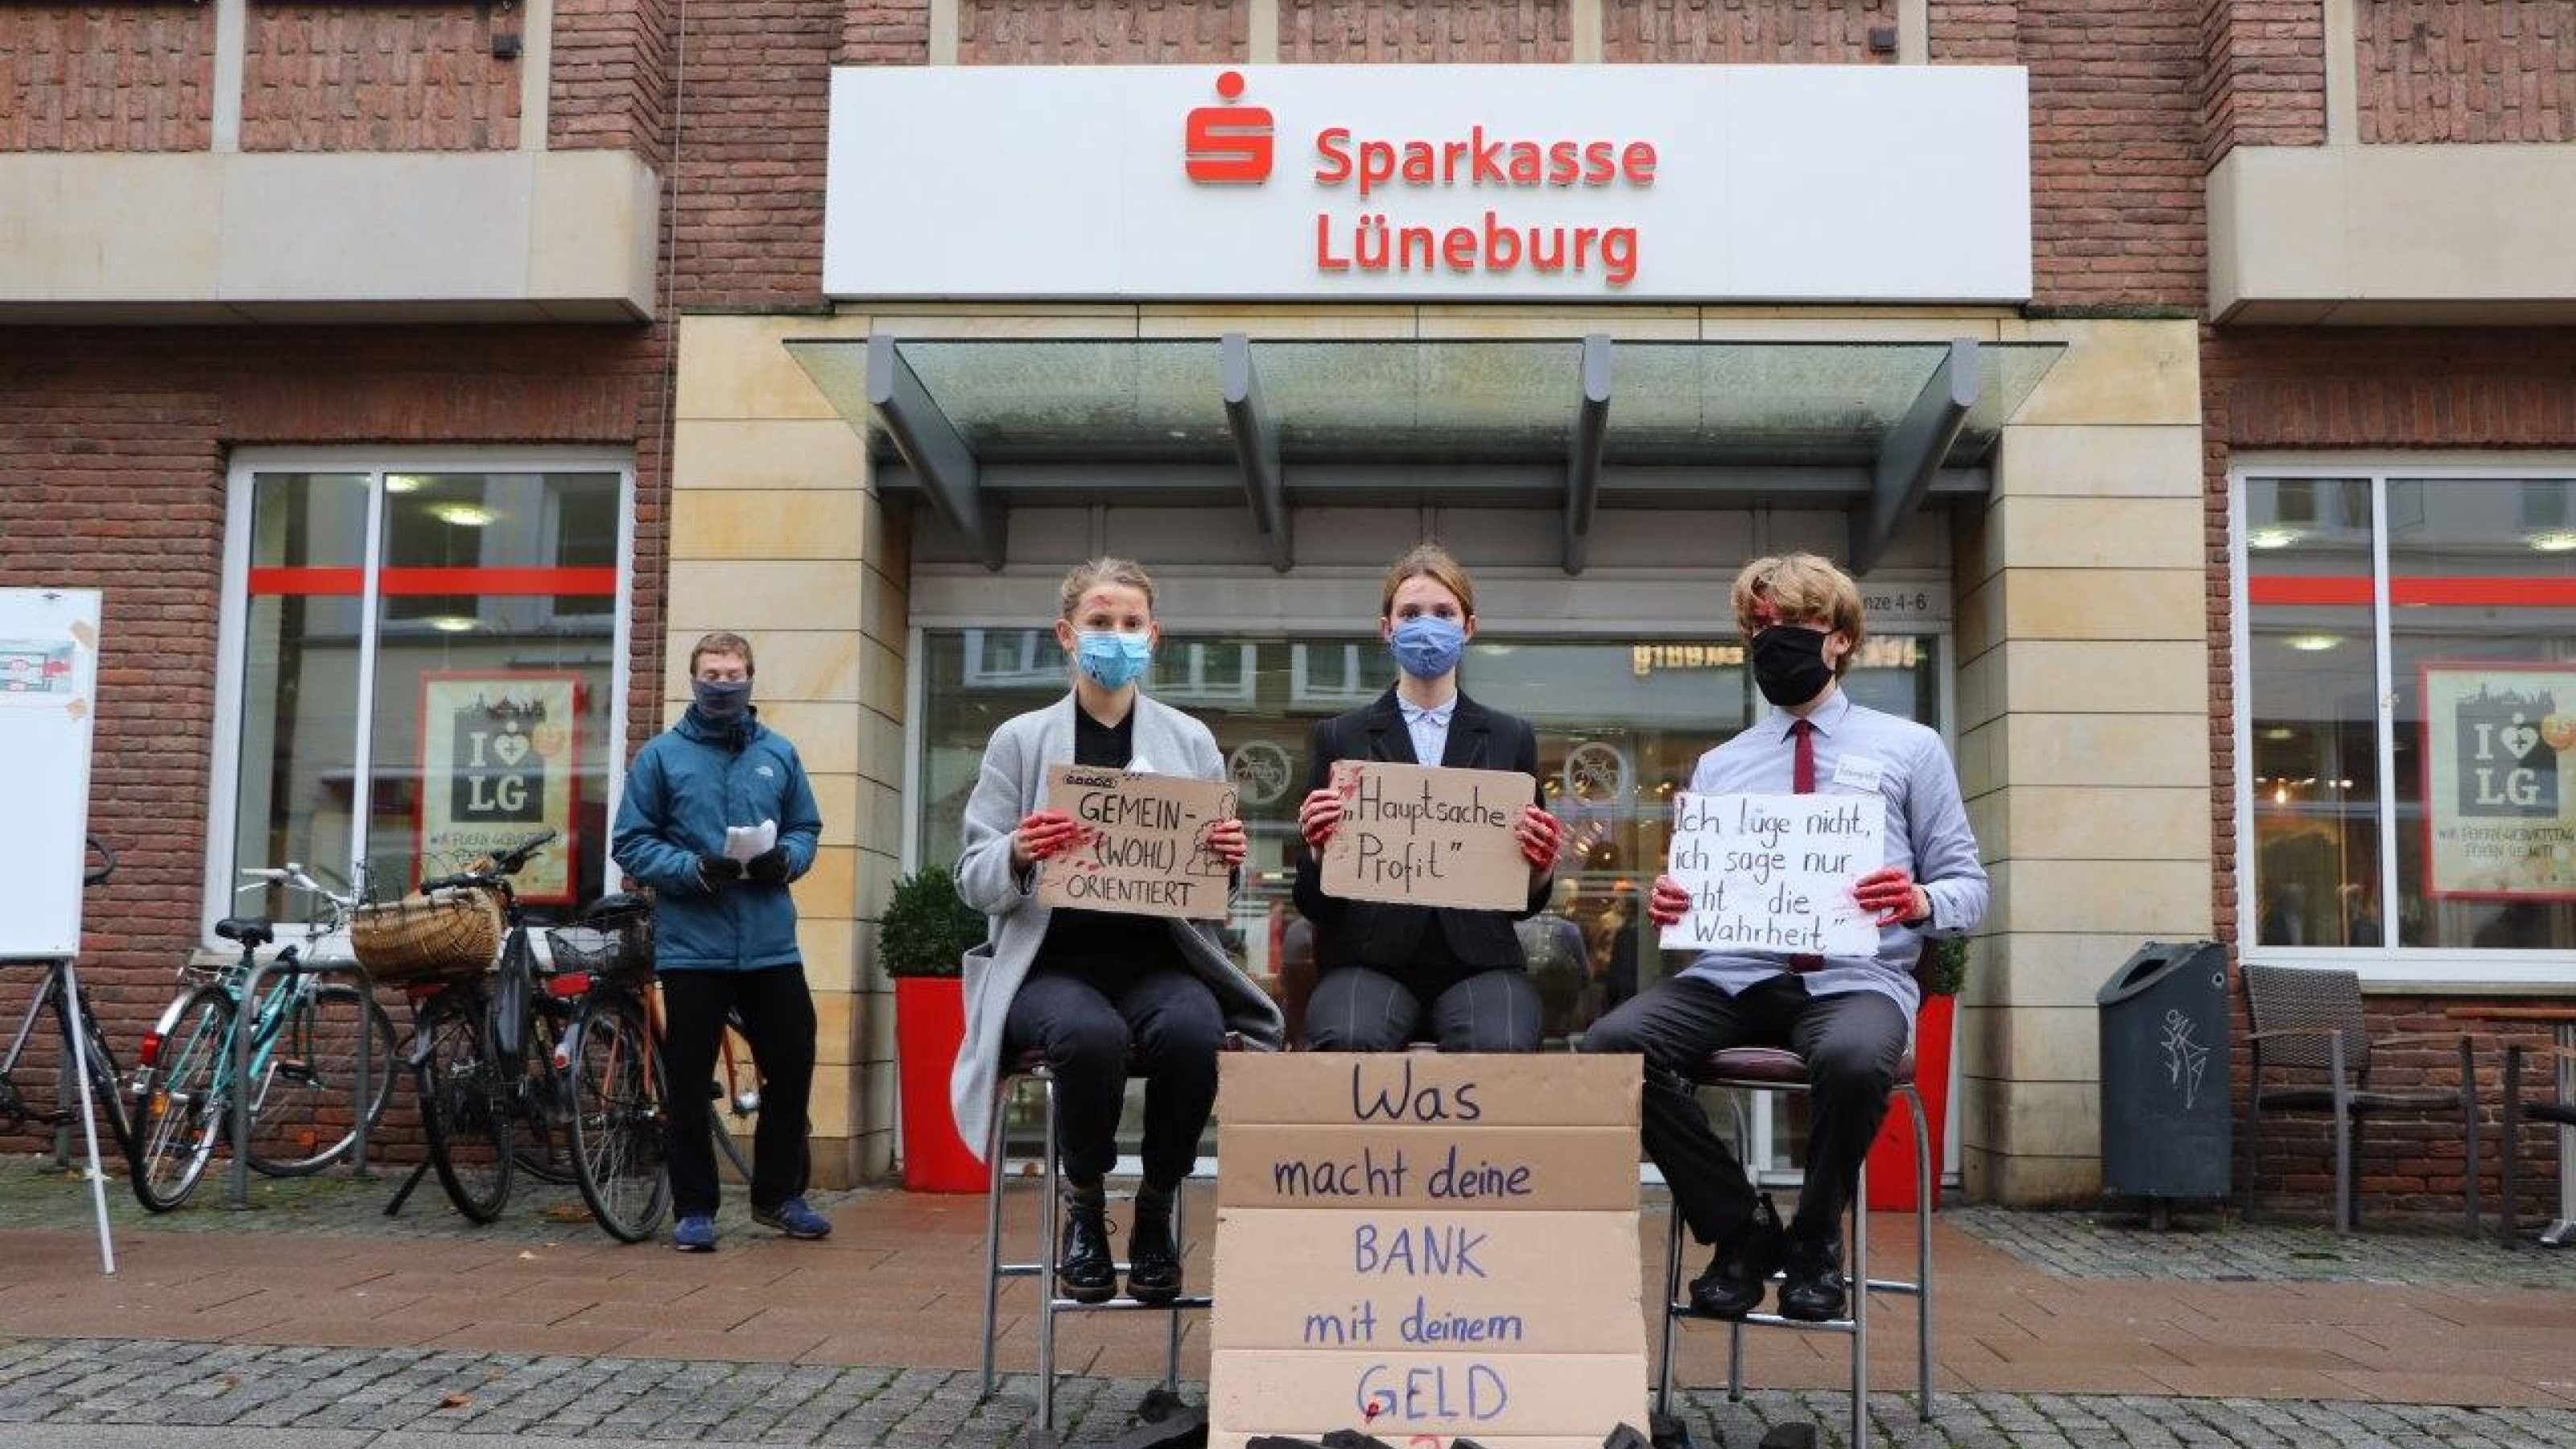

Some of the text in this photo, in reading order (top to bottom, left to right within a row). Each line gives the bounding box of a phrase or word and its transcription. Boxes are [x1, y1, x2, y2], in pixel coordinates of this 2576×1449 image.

[1314, 125, 1658, 198] Sparkasse
[1316, 210, 1639, 287] Lüneburg
[470, 731, 488, 767] I
[2475, 723, 2494, 760] I
[468, 774, 528, 811] LG
[2475, 767, 2541, 806] LG
[1079, 791, 1196, 830] GEMEIN-
[1739, 798, 1790, 848] lüge
[1806, 803, 1871, 838] nicht,
[1096, 836, 1176, 875] (WOHL)
[1675, 838, 1852, 885] ich sage nur
[1066, 874, 1196, 907] ORIENTIERT
[1690, 881, 1810, 914] cht die
[1352, 1059, 1482, 1122] Was
[1274, 1146, 1531, 1198] macht deine
[1354, 1224, 1488, 1278] BANK
[1303, 1295, 1522, 1344] mit deinem
[1356, 1364, 1508, 1422] GELD
